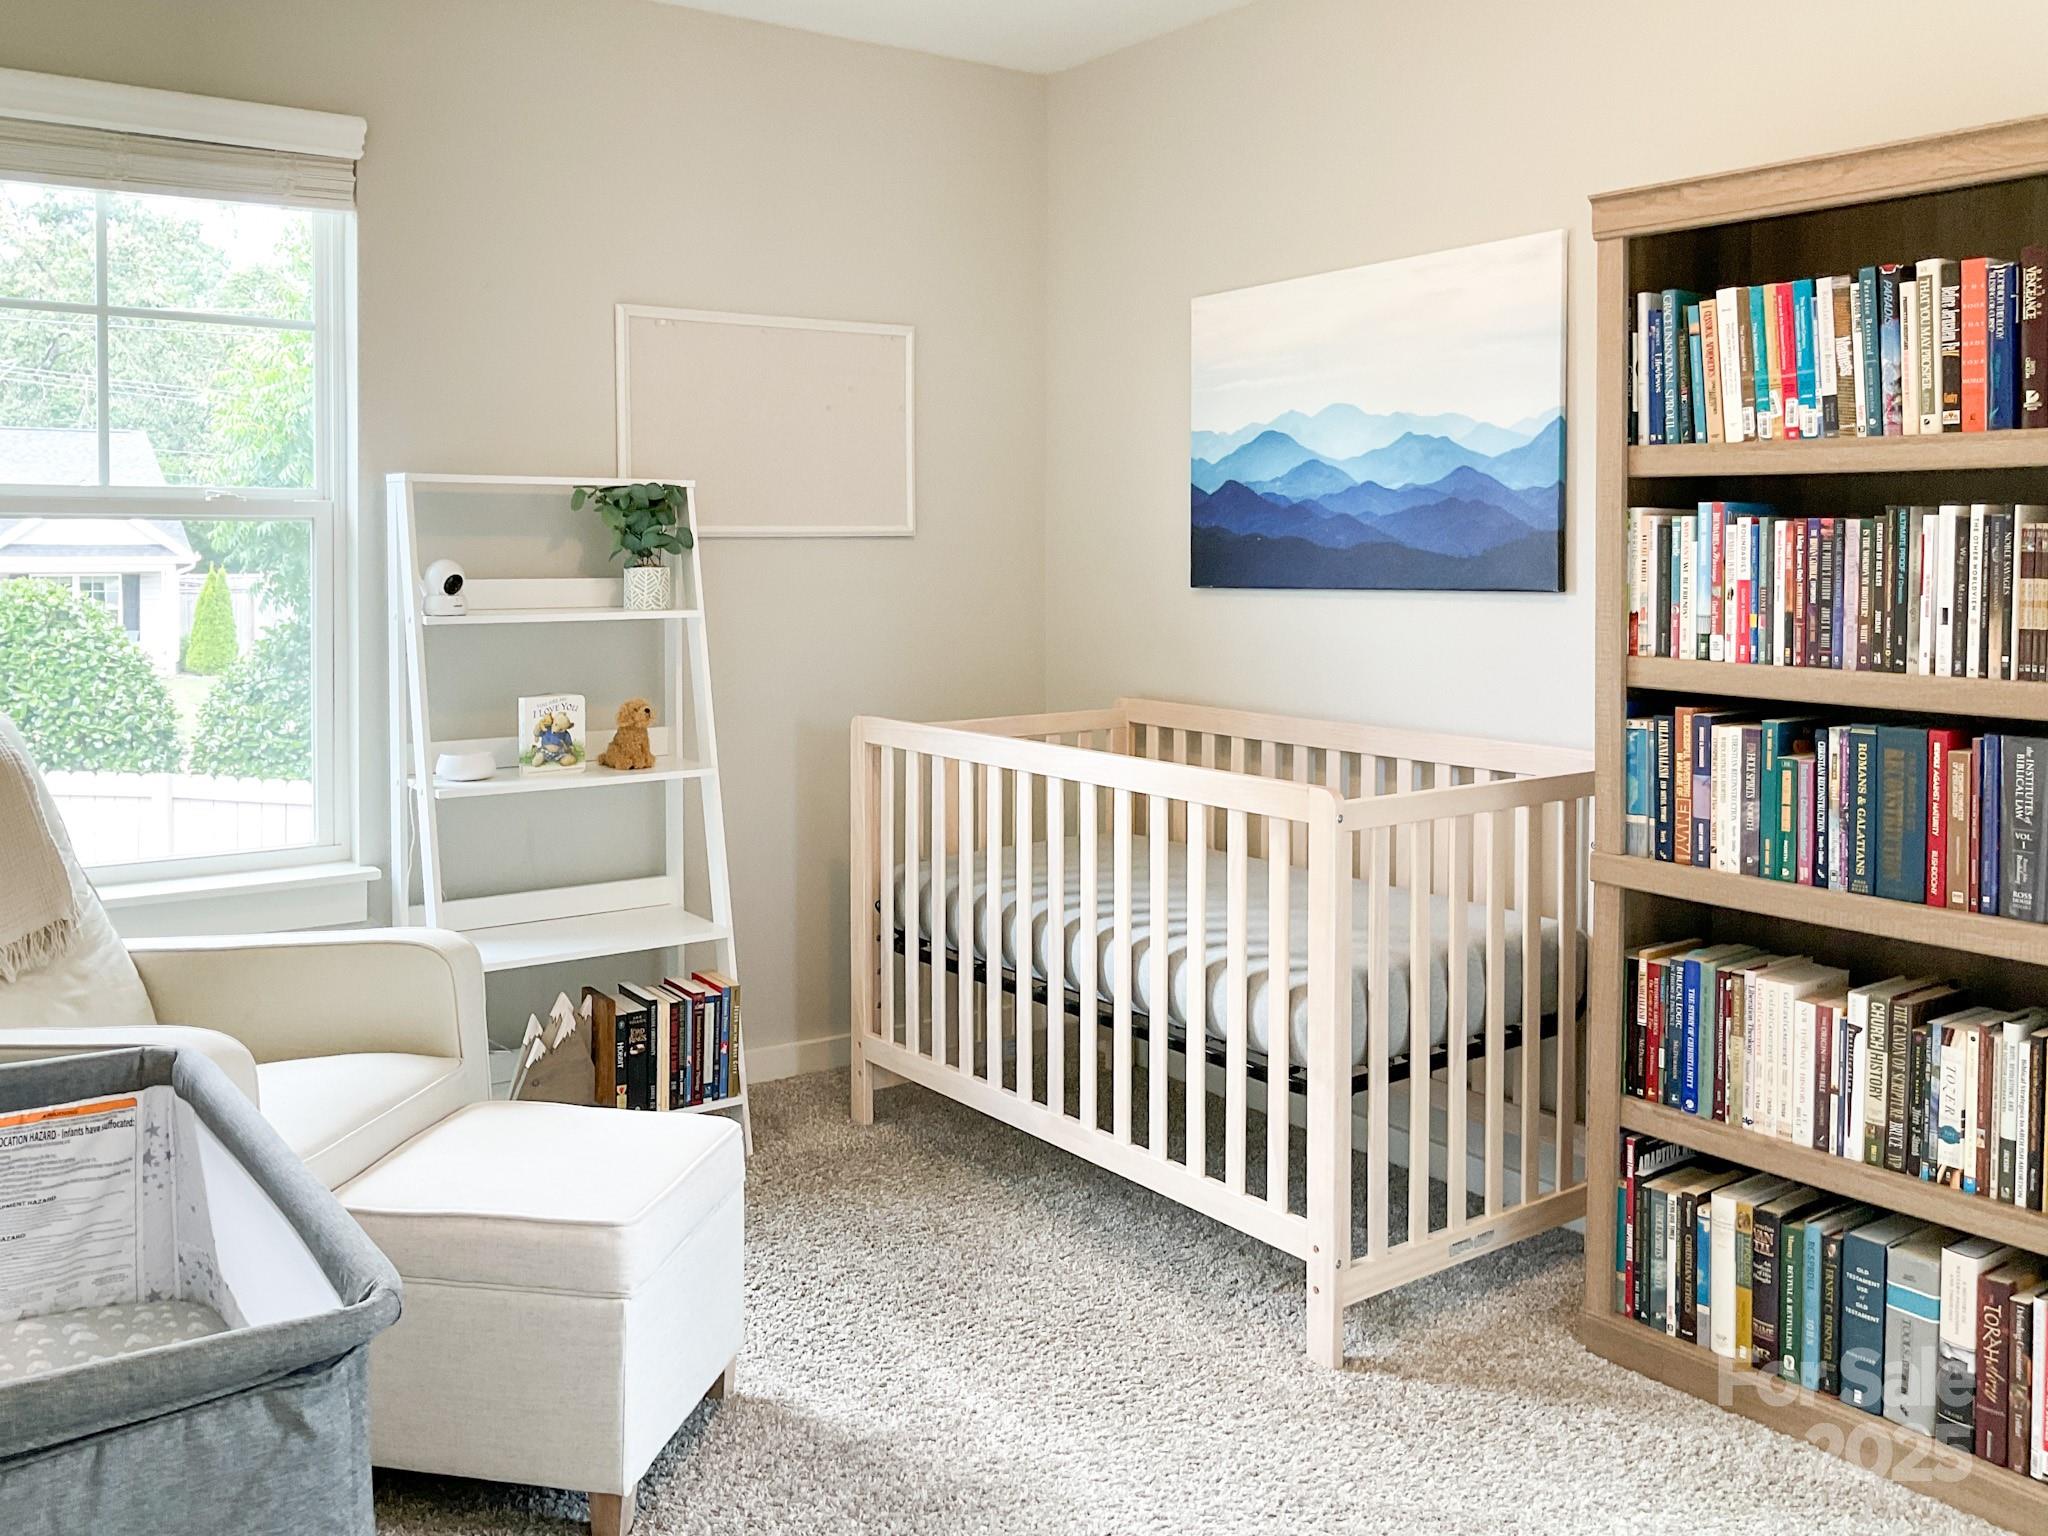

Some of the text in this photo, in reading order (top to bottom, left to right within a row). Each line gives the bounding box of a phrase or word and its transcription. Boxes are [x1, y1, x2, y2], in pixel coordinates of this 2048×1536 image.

[1941, 285, 1960, 308] Before
[2025, 266, 2036, 319] VENGEANCE
[1865, 319, 1873, 355] Restored
[1920, 278, 1931, 390] THAT YOU MAY PROSPER
[1941, 309, 1960, 342] Jerusalem
[1663, 295, 1674, 431] GRACE UNKNOWN SPROUL
[1836, 336, 1853, 376] Madness
[1795, 535, 1804, 550] King
[1862, 537, 1870, 548] THE
[1683, 562, 1689, 573] WE
[1795, 569, 1803, 582] Only
[1861, 549, 1869, 576] MORMON
[1898, 548, 1906, 572] PROOF
[2003, 532, 2012, 595] NOBLE SAVAGES
[1957, 546, 1966, 613] Way Master
[1860, 624, 1868, 643] WHITE
[539, 702, 579, 718] LOVE YOU
[1658, 720, 1669, 778] MILLENNIALISM
[1933, 742, 1941, 769] REVOLT
[1677, 787, 1683, 797] OF
[1745, 773, 1755, 831] SPIRITS NORTH
[1817, 741, 1826, 832] CHRISTIAN RECONSTRUCTION
[2015, 754, 2025, 819] BIBLICAL LAW
[2025, 760, 2035, 816] INSTITUTES
[1677, 799, 1690, 852] ENVY
[1855, 743, 1867, 876] ROMANS & GALATIANS
[1931, 802, 1939, 836] MATURITY
[2015, 832, 2032, 841] VOL
[2012, 890, 2032, 899] ROSS
[1675, 966, 1684, 1029] BIBLICAL LOGIC
[1747, 985, 1755, 1021] Liberation
[1686, 988, 1696, 1088] THE STORY OF CHRISTIANITY
[1746, 1024, 1754, 1055] Theology
[1820, 1026, 1828, 1055] ORIGIN
[1869, 1002, 1885, 1102] CHURCH HISTORY
[1847, 1028, 1855, 1094] Justification
[1925, 1063, 1930, 1074] ME
[1888, 1005, 1907, 1168] THE CANON OF SCRIPTURE BRUCE IVP
[1942, 1065, 1957, 1116] TOZER
[2018, 1085, 2026, 1119] Strategies
[30, 1130, 56, 1141] HAZARD
[62, 1128, 84, 1138] Infants
[85, 1126, 102, 1135] have
[101, 1118, 135, 1132] suffocated:
[1910, 1107, 1922, 1156] Here Stand
[2018, 1128, 2026, 1160] ABOLISH
[2017, 1161, 2025, 1199] ABORTION
[1753, 1228, 1774, 1246] VAN
[1684, 1234, 1693, 1314] CHRISTIAN ETHICS
[1846, 1272, 1880, 1288] TESTAMENT
[1856, 1267, 1870, 1275] OLD
[1856, 1286, 1869, 1294] USE
[1856, 1302, 1868, 1311] OLD
[1823, 1269, 1833, 1361] ERNEST REISINGER
[1845, 1306, 1880, 1324] TESTAMENT
[2013, 1305, 2025, 1340] Defending
[1983, 1304, 2003, 1361] TORAH
